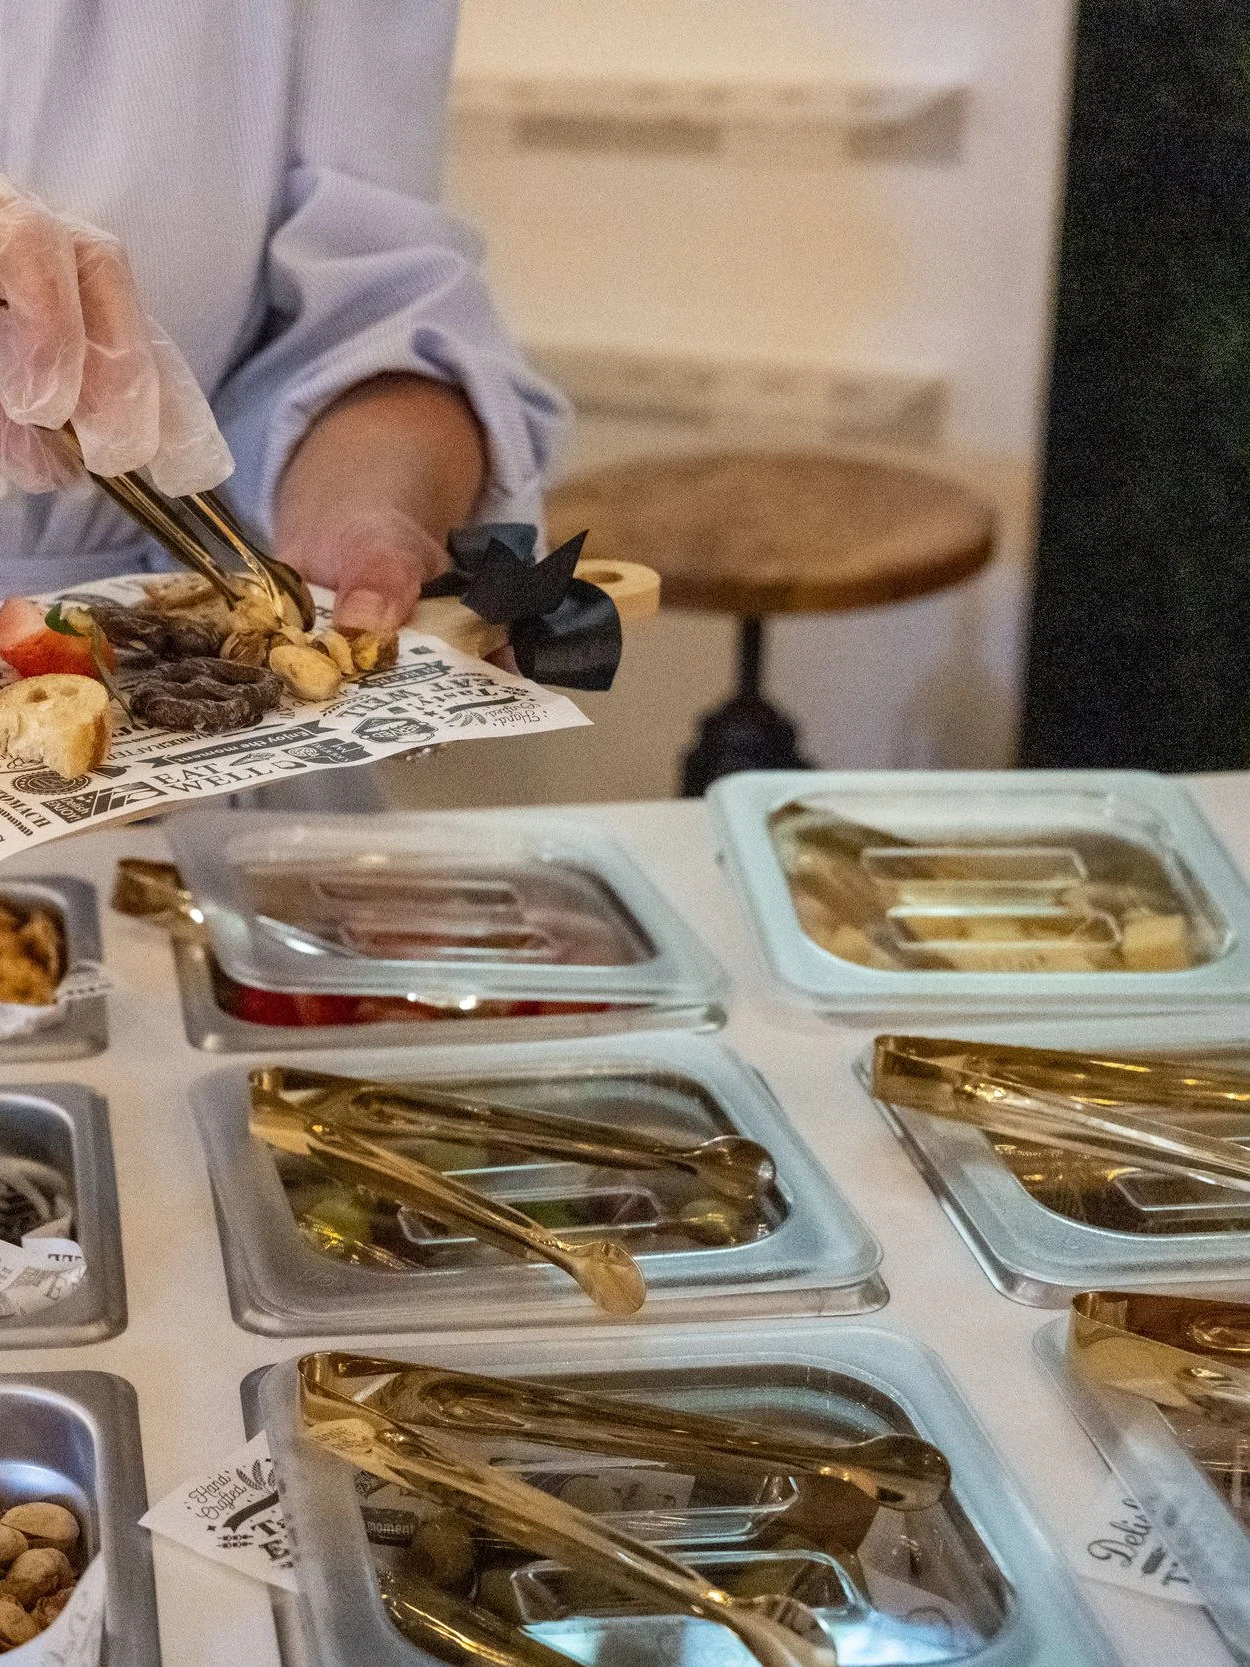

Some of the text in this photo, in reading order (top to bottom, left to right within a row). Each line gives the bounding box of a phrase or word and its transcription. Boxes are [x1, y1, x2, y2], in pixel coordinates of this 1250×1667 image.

[179, 730, 307, 763] Enjoy the moment
[150, 762, 224, 786] EAT
[168, 765, 274, 794] WELL
[187, 1472, 232, 1504] Hand
[195, 1483, 248, 1521] Crafted
[366, 1519, 416, 1536] moment
